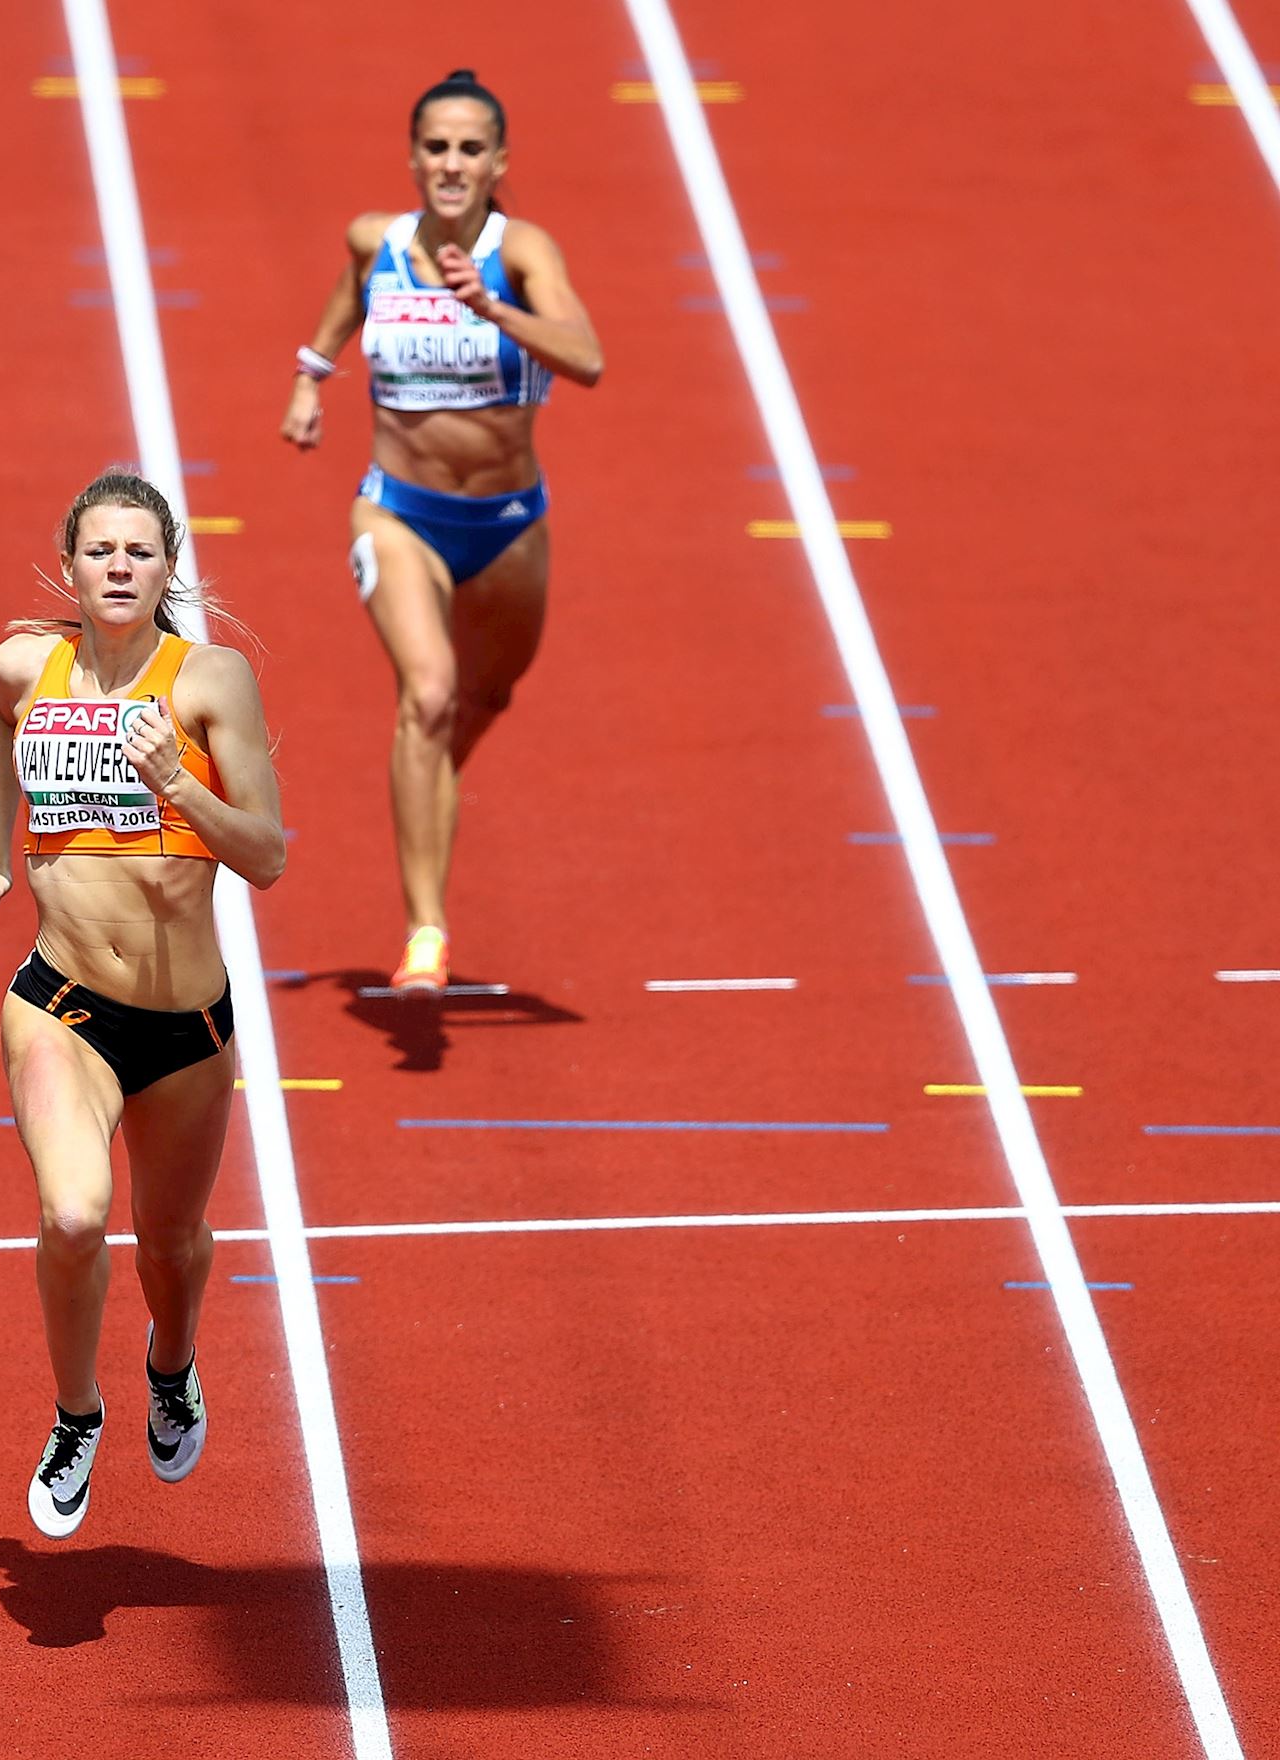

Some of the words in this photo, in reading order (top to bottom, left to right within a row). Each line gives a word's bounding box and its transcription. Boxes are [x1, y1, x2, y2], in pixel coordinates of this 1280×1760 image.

[372, 296, 457, 324] SPAR
[25, 706, 118, 732] SPAR
[21, 741, 51, 781] VAN
[55, 741, 141, 783] LEUVERE
[42, 792, 48, 804] I
[50, 792, 76, 805] RUN
[78, 793, 119, 806] CLEAN
[120, 810, 156, 826] 2016
